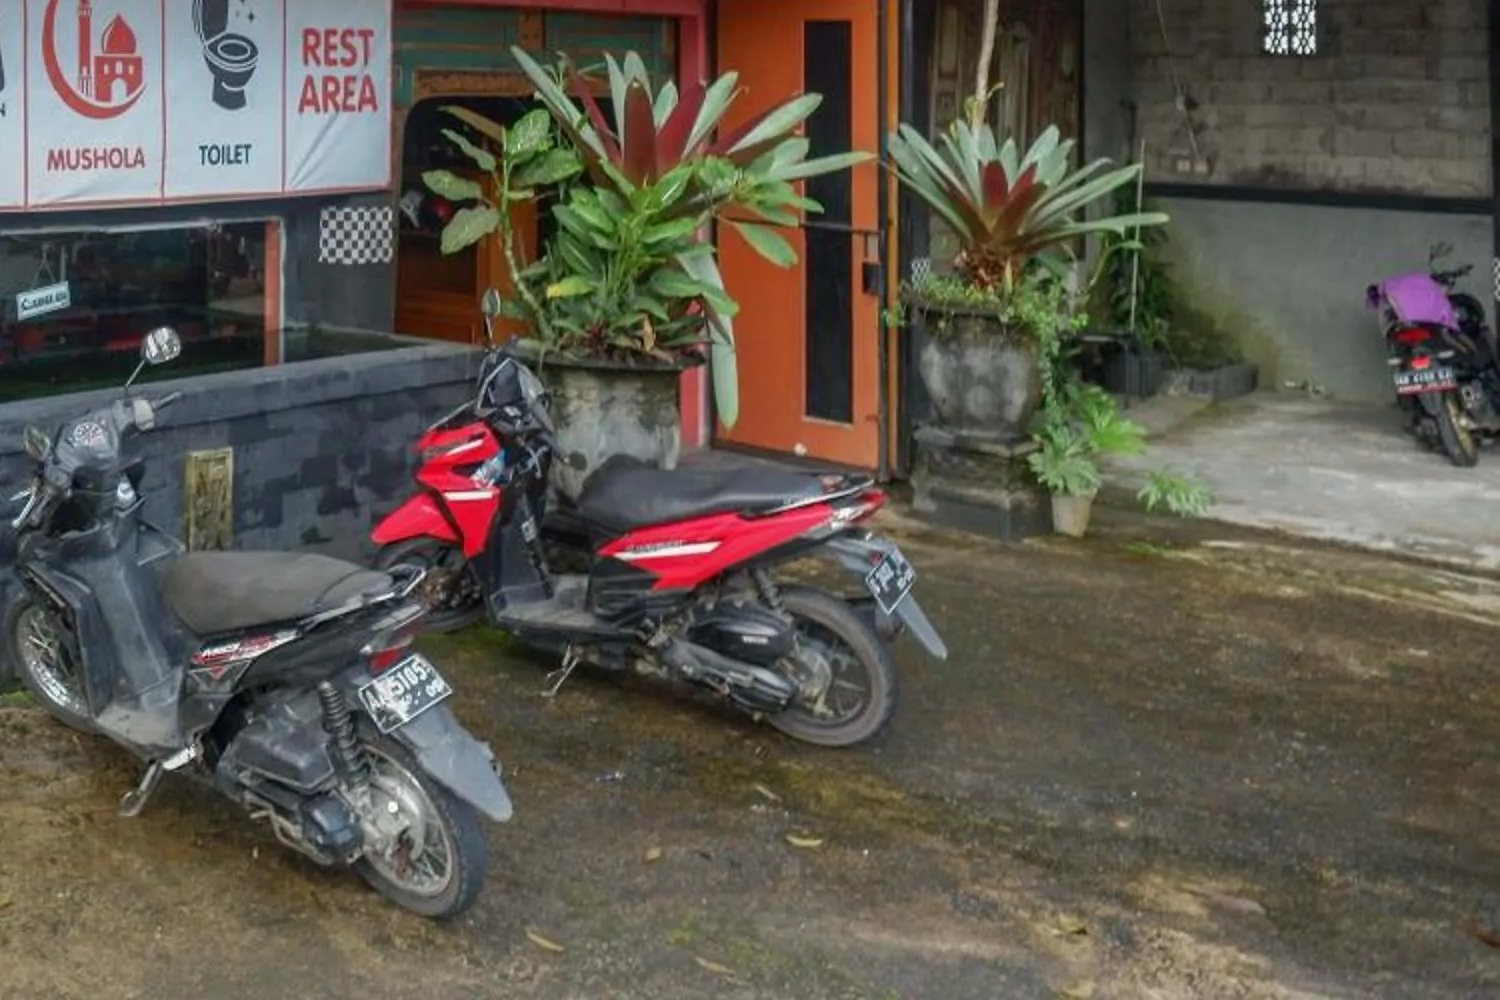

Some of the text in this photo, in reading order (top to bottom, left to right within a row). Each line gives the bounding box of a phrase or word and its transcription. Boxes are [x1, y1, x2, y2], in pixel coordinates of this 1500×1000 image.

[302, 27, 374, 68] REST
[299, 73, 378, 113] AREA
[47, 148, 145, 171] MUSHOLA
[199, 144, 252, 166] TOILET
